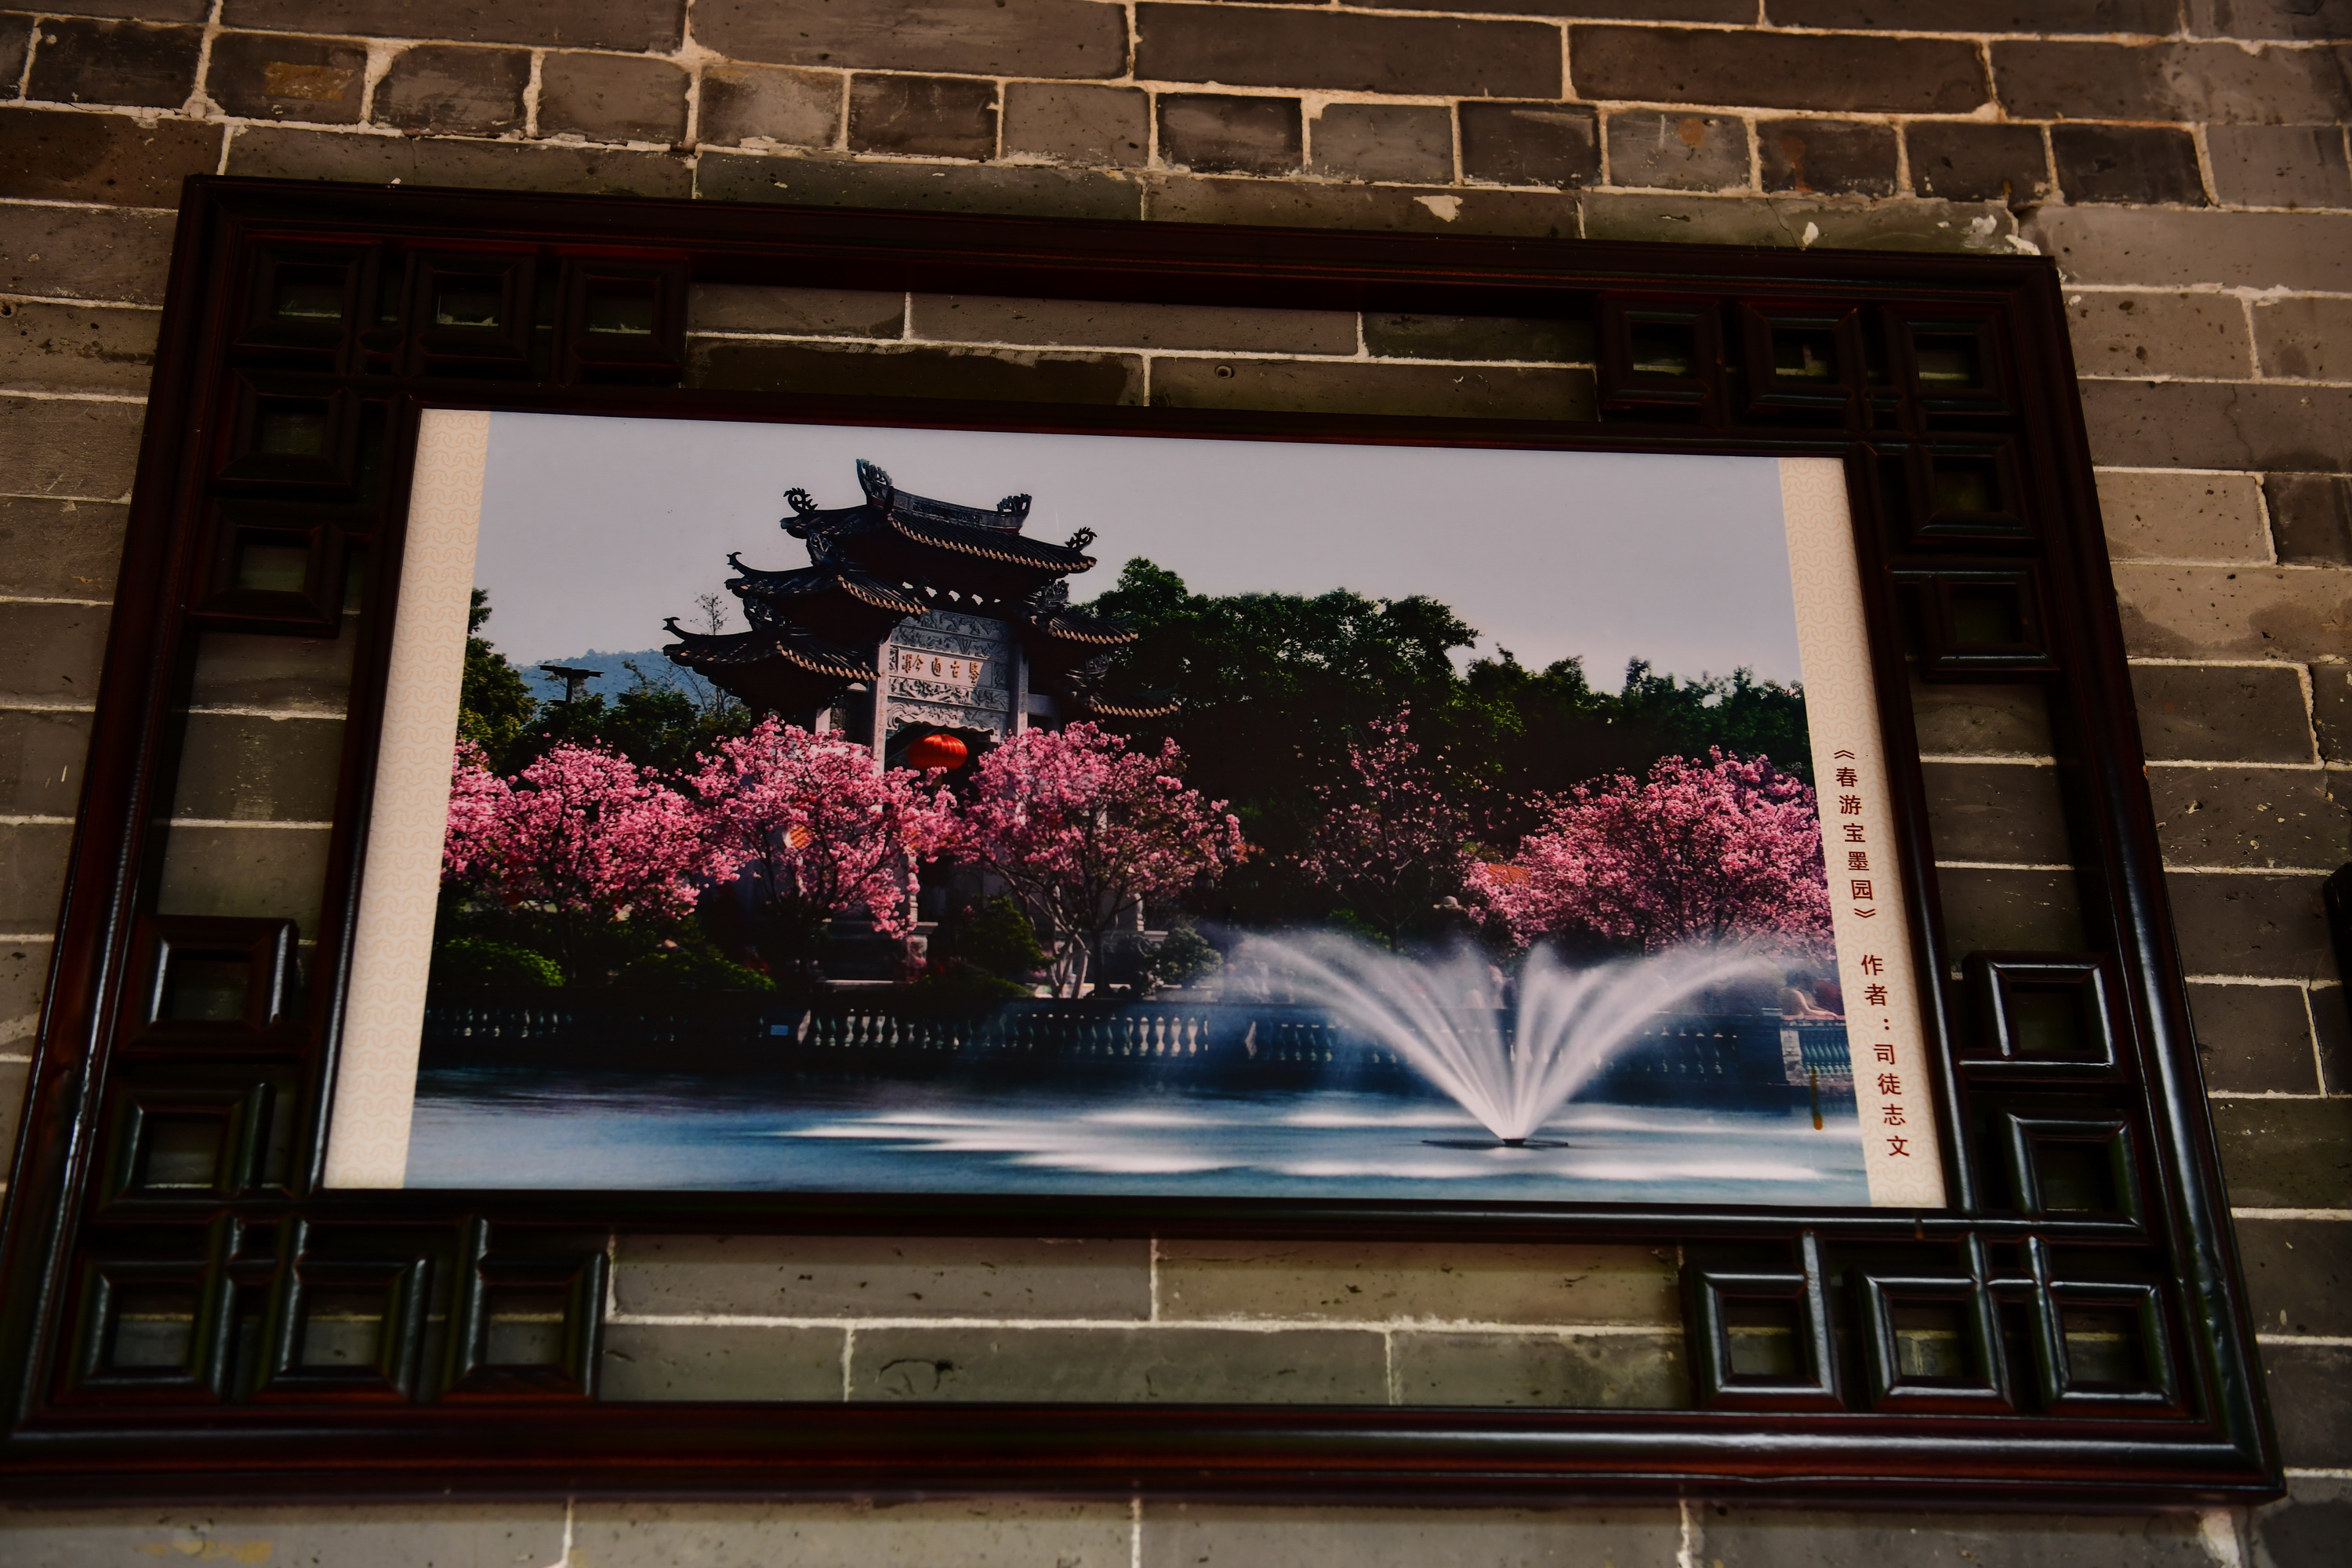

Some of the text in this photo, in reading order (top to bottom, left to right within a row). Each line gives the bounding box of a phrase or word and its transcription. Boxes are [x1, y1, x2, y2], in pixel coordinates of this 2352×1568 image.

[1834, 750, 1876, 918] 《春游宝墨园》
